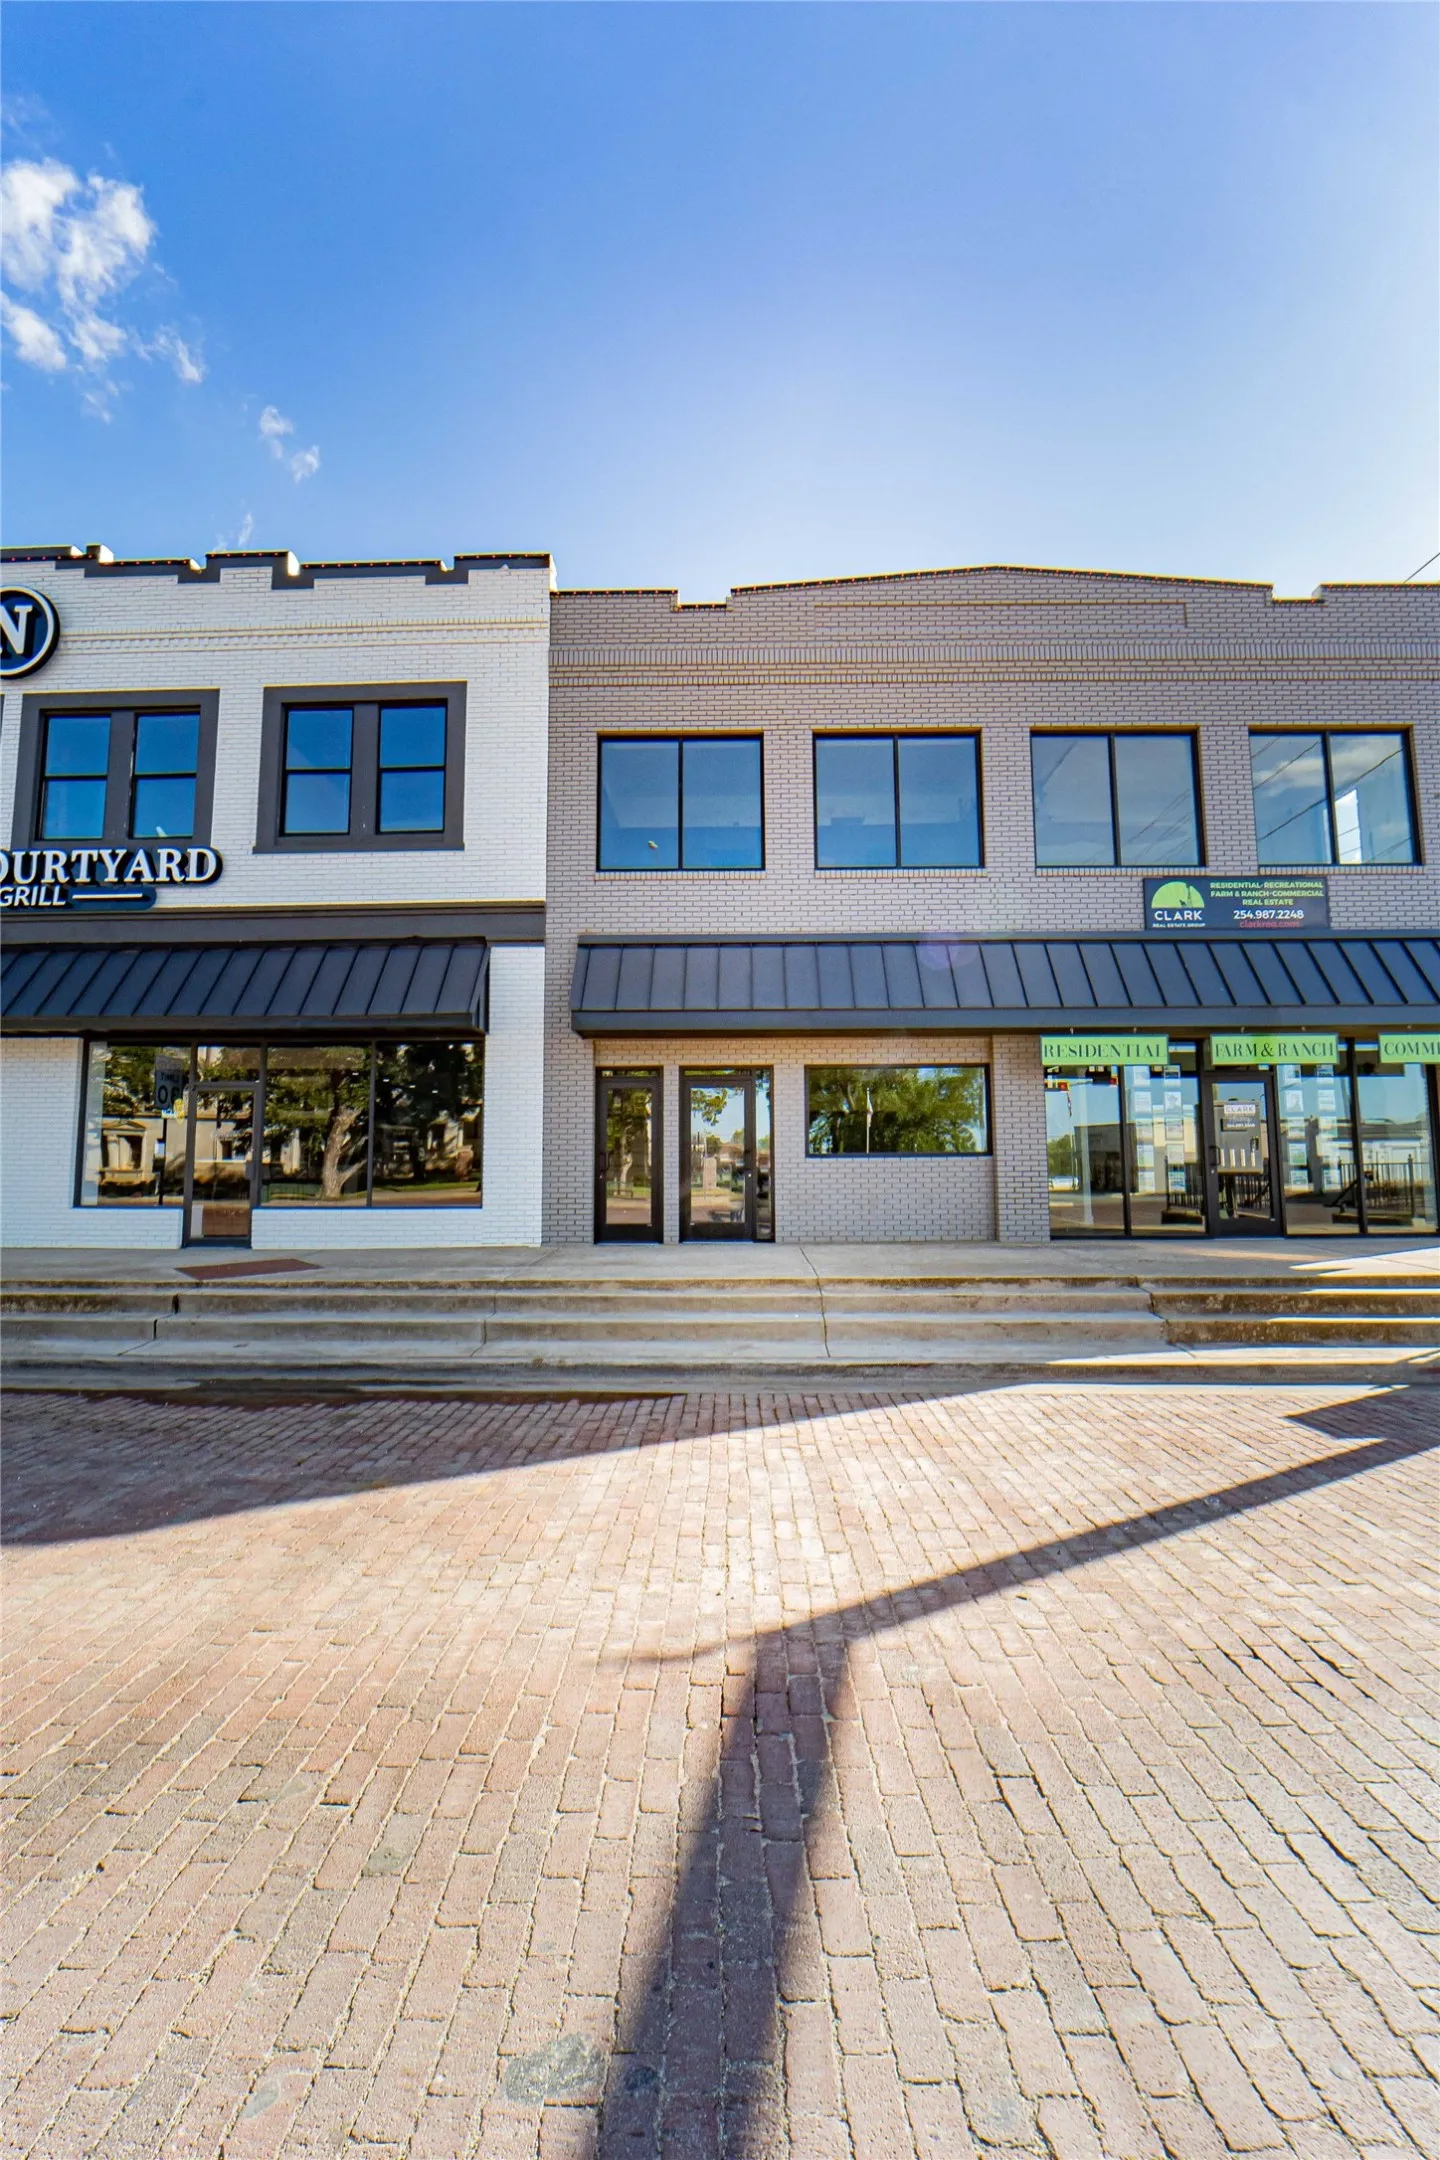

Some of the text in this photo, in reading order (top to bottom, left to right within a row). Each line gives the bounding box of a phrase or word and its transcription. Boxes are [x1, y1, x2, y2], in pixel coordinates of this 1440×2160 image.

[0, 604, 33, 655] N
[0, 885, 66, 907] GRILL
[1154, 910, 1203, 921] CLARK
[1233, 909, 1304, 920] 254.987.2248
[1043, 1043, 1166, 1058] RESIDENTIAL
[1215, 1042, 1334, 1057] FARM & RANCH
[1384, 1041, 1440, 1056] COMM
